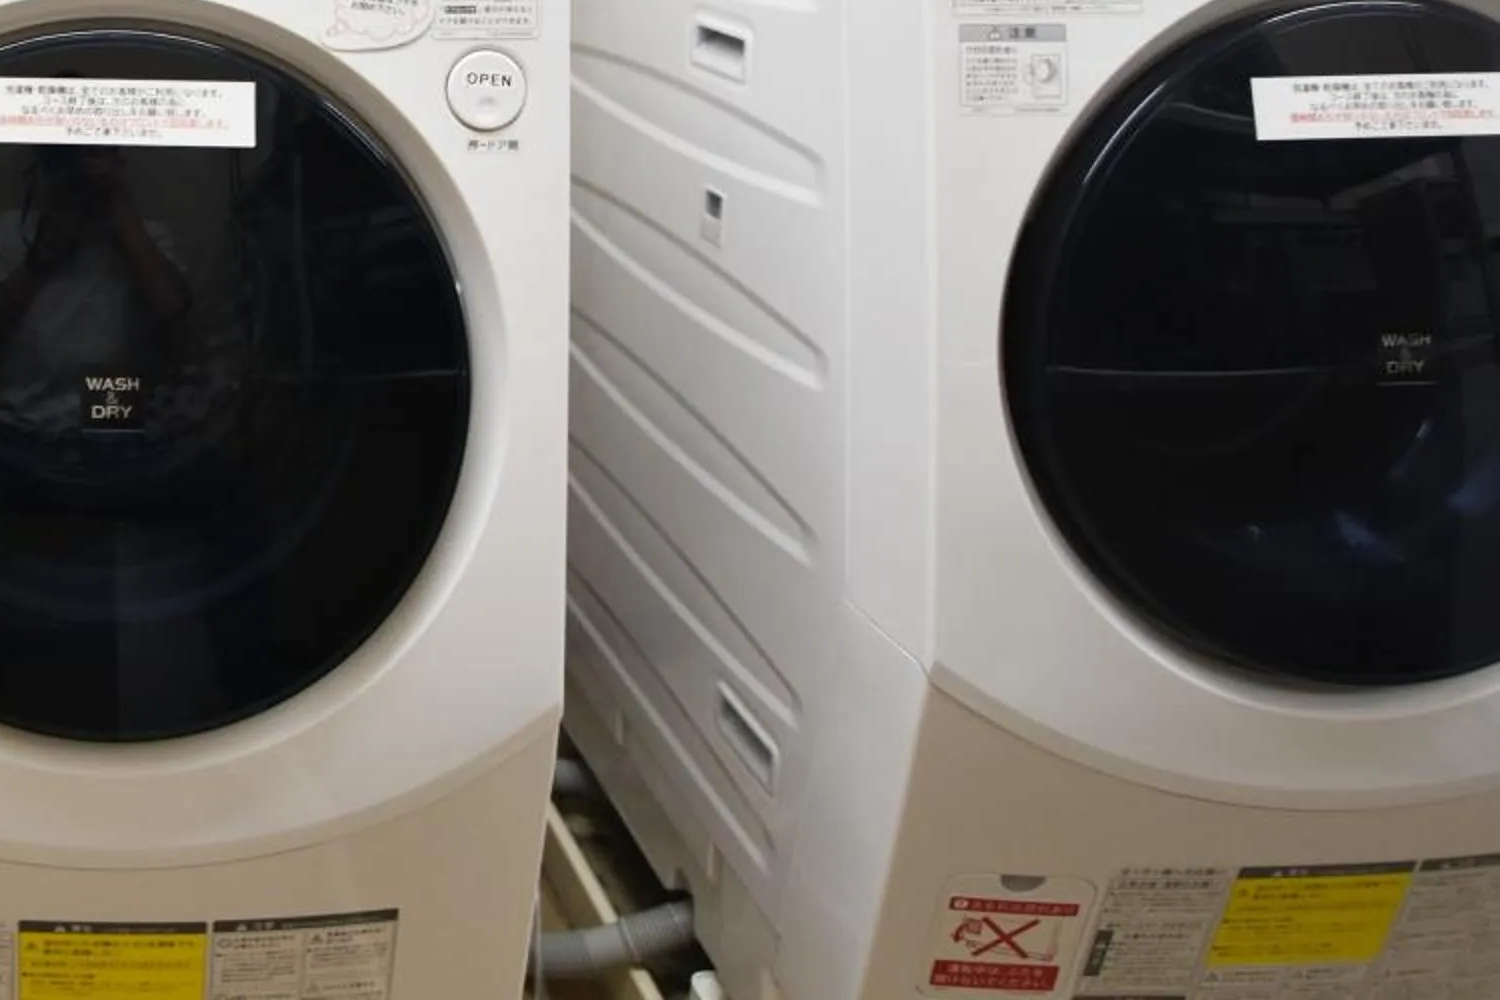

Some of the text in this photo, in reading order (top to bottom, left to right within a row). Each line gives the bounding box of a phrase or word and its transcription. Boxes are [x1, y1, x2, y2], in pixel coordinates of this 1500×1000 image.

[466, 71, 513, 87] OPEN
[1381, 332, 1433, 347] WASH
[1385, 360, 1425, 374] DRY
[85, 376, 141, 391] WASH
[91, 404, 133, 419] DRY
